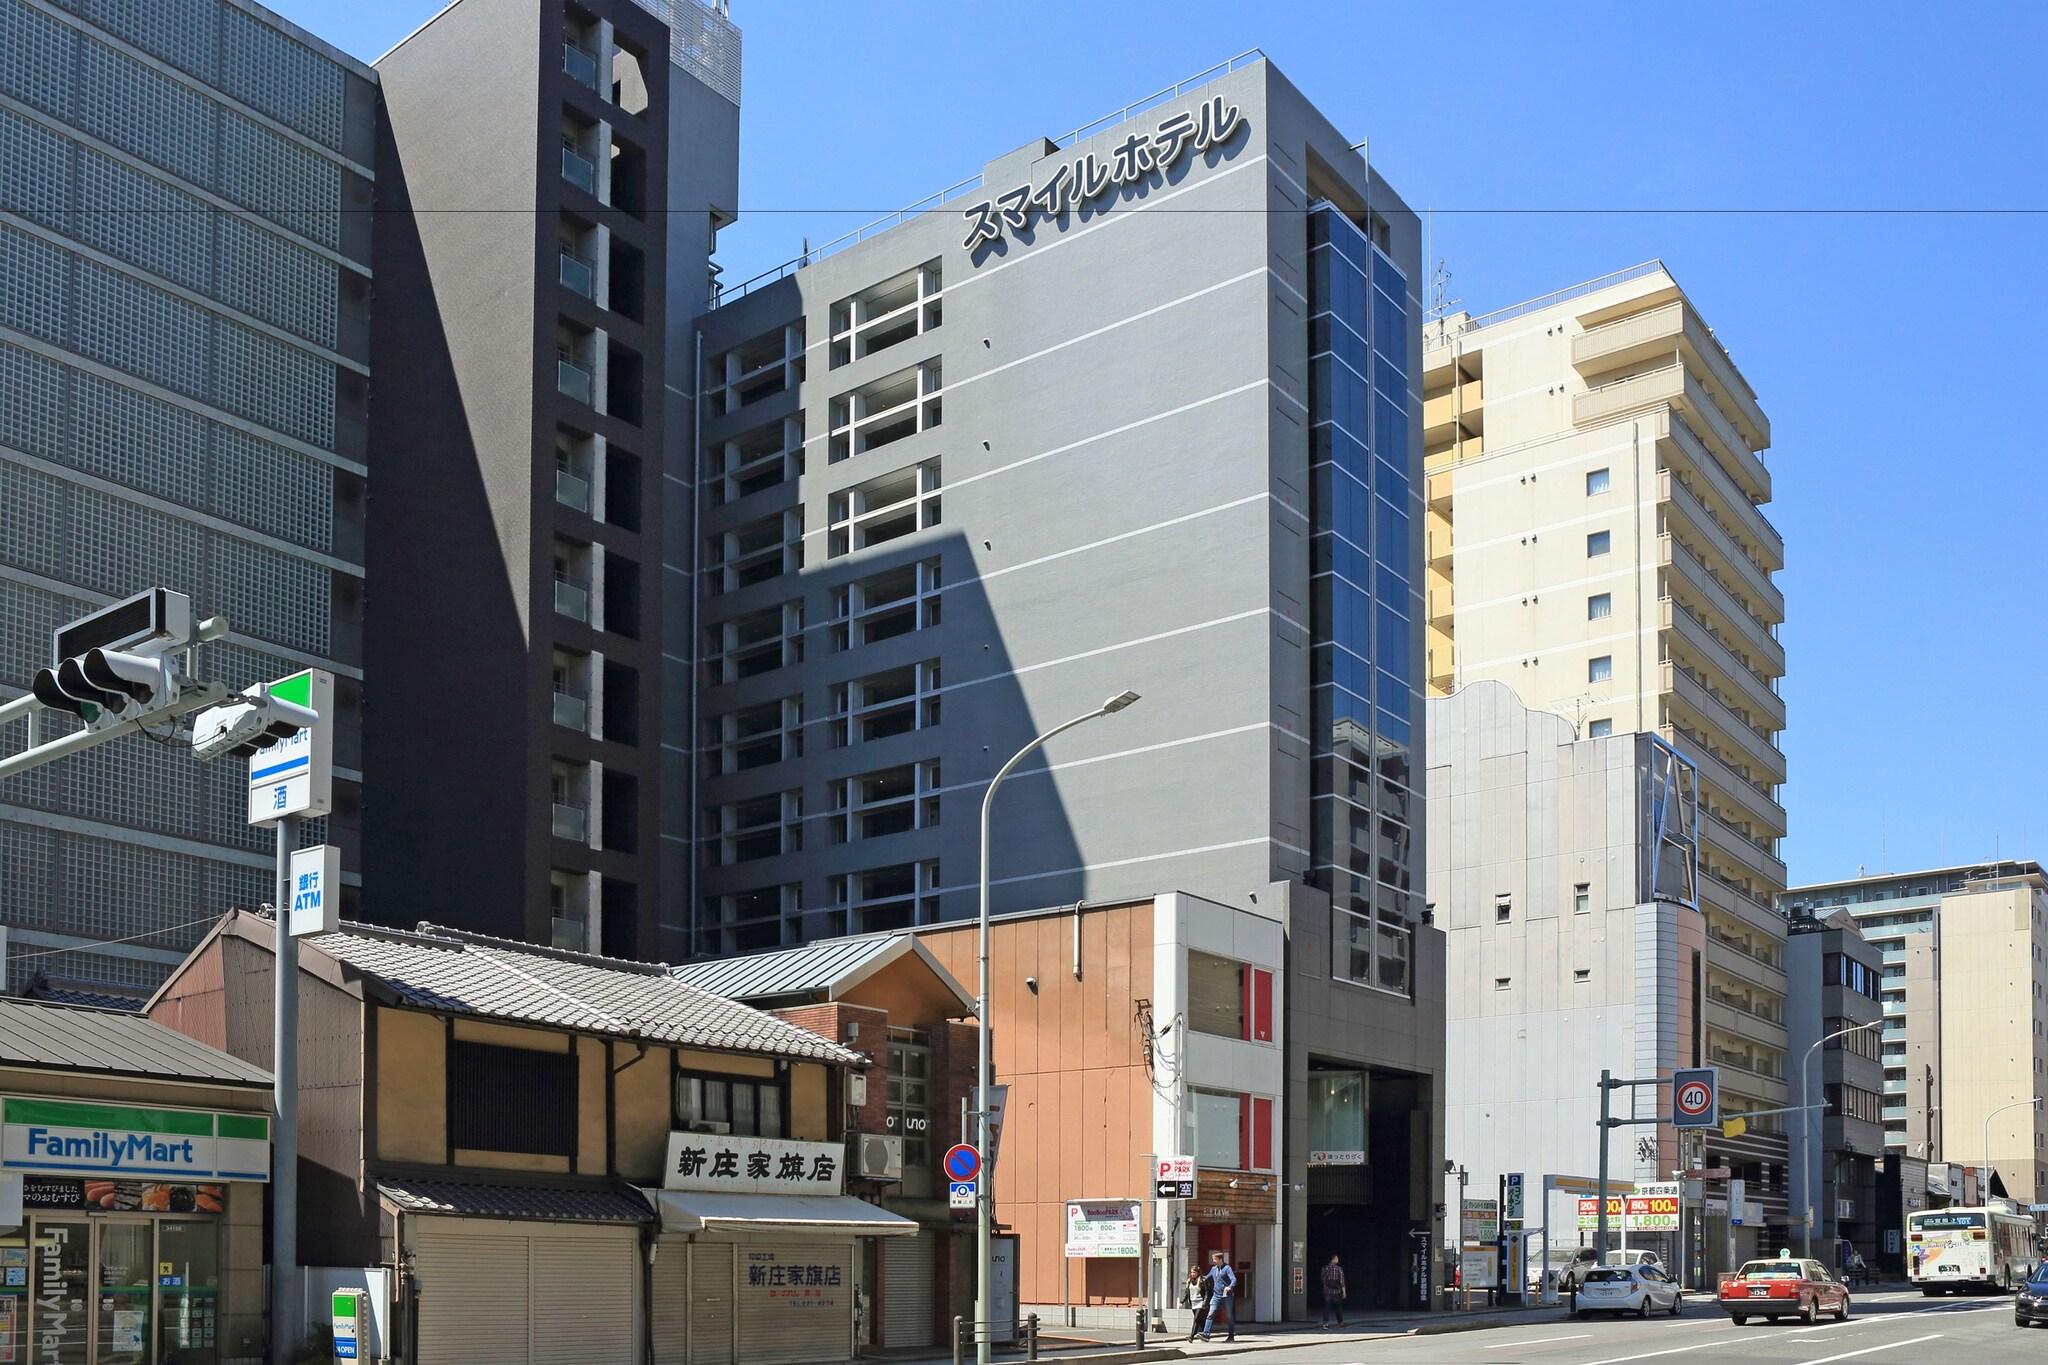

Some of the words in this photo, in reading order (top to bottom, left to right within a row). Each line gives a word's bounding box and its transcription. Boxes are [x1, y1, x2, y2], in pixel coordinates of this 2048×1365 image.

[962, 94, 1240, 249] スマイルホテル
[273, 785, 288, 810] 酒
[299, 871, 319, 891] 銀行
[294, 890, 321, 911] ATM
[1685, 1091, 1704, 1105] 40
[906, 1118, 926, 1130] uno
[28, 1127, 193, 1166] FamilyMart
[678, 1146, 837, 1182] 新庄家旗店
[1160, 1162, 1171, 1177] P
[1511, 1177, 1519, 1185] P
[1071, 1208, 1078, 1217] P
[748, 1264, 841, 1287] 新庄家旗店
